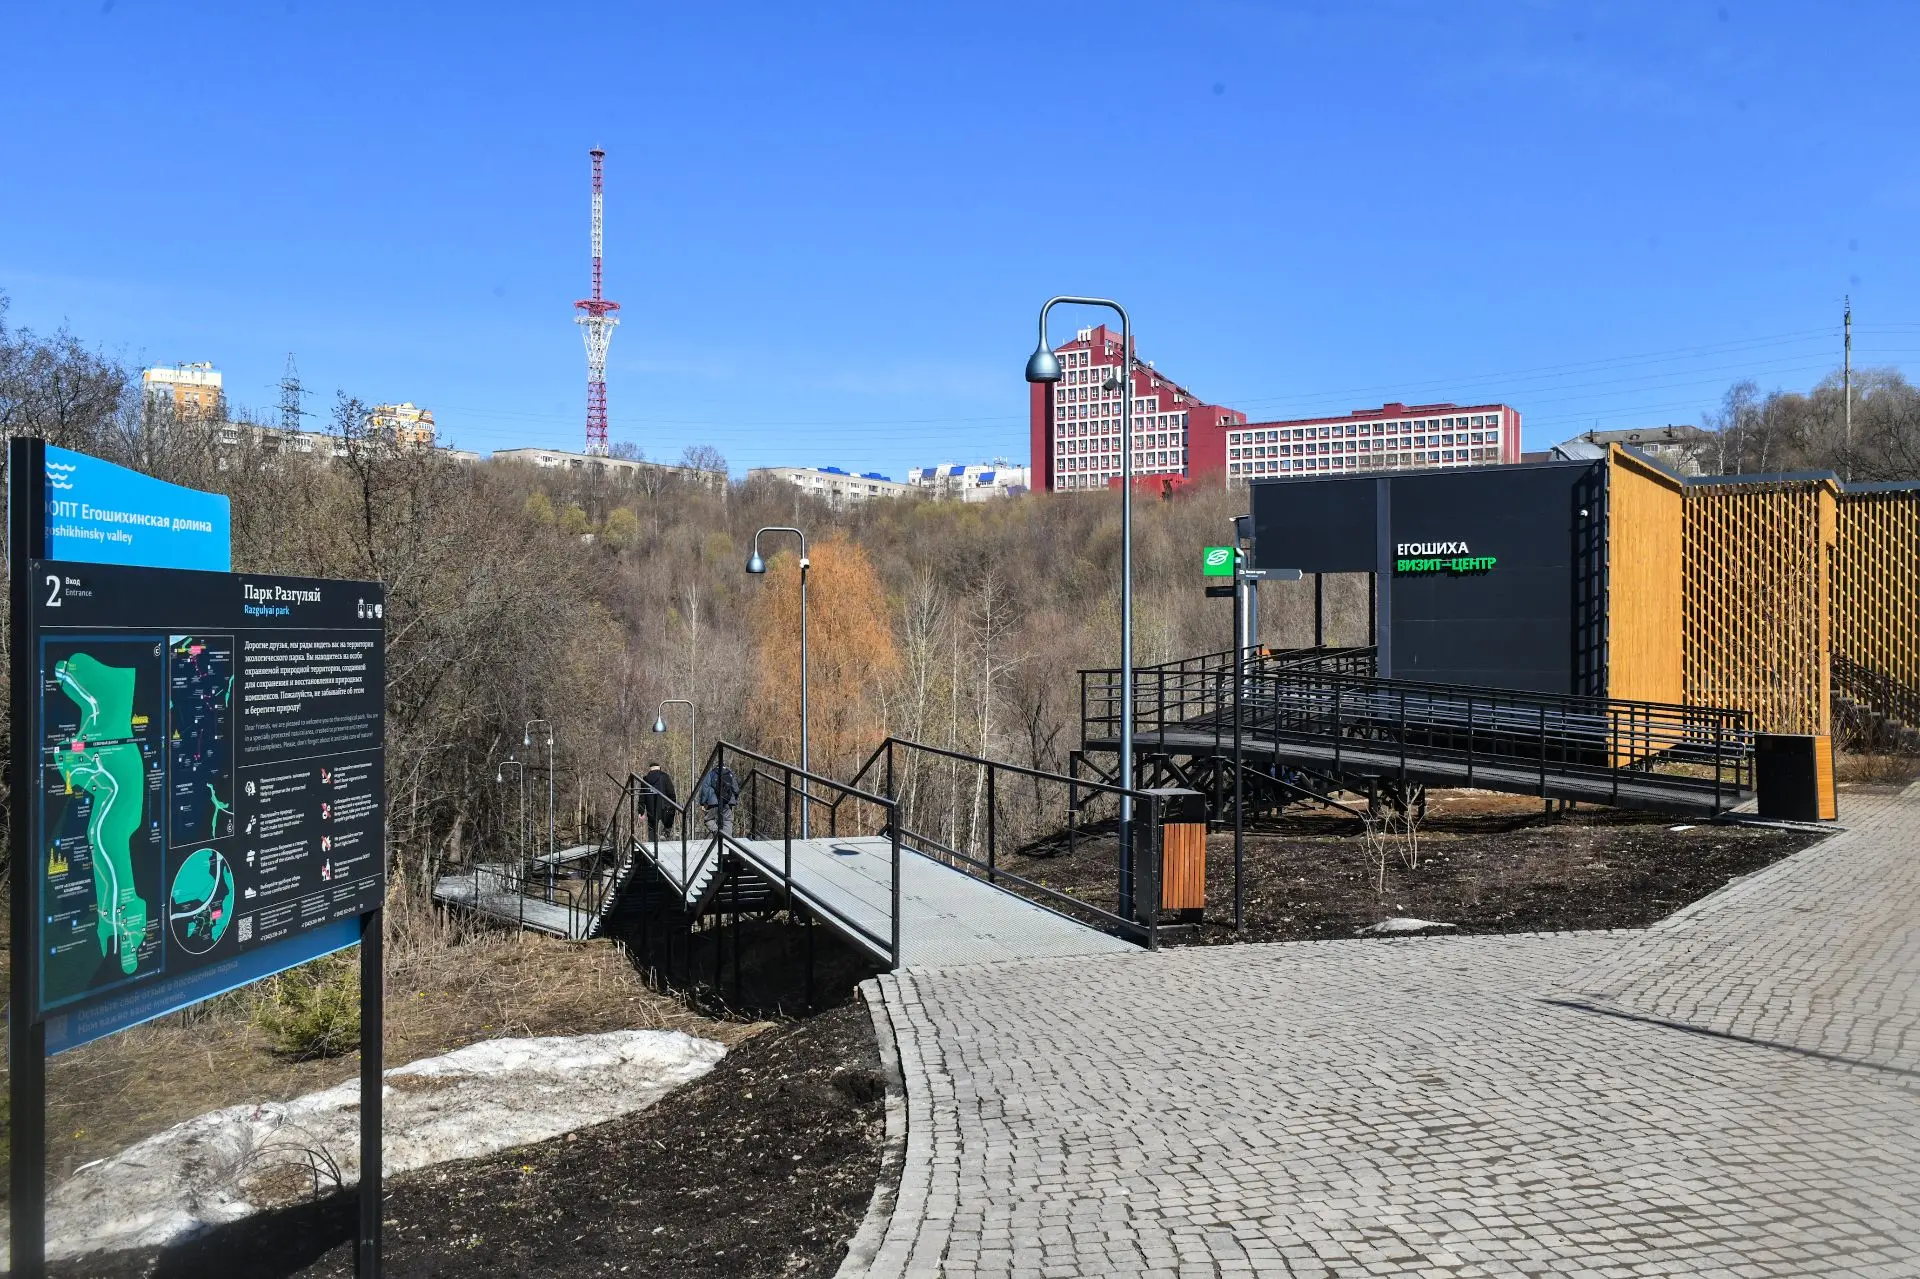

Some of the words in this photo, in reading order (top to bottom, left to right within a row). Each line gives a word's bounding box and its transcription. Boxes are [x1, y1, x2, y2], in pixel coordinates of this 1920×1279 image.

[44, 500, 78, 518] ОПТ
[82, 504, 170, 528] Егошихинская
[172, 518, 212, 532] долина
[107, 530, 132, 545] valley
[1398, 542, 1469, 556] ЕГОШИХА
[65, 577, 80, 586] Вход
[46, 575, 61, 607] 2
[244, 584, 272, 604] Парк
[275, 586, 321, 605] Разгуляй
[244, 604, 275, 617] Razgulyai
[276, 606, 289, 617] park
